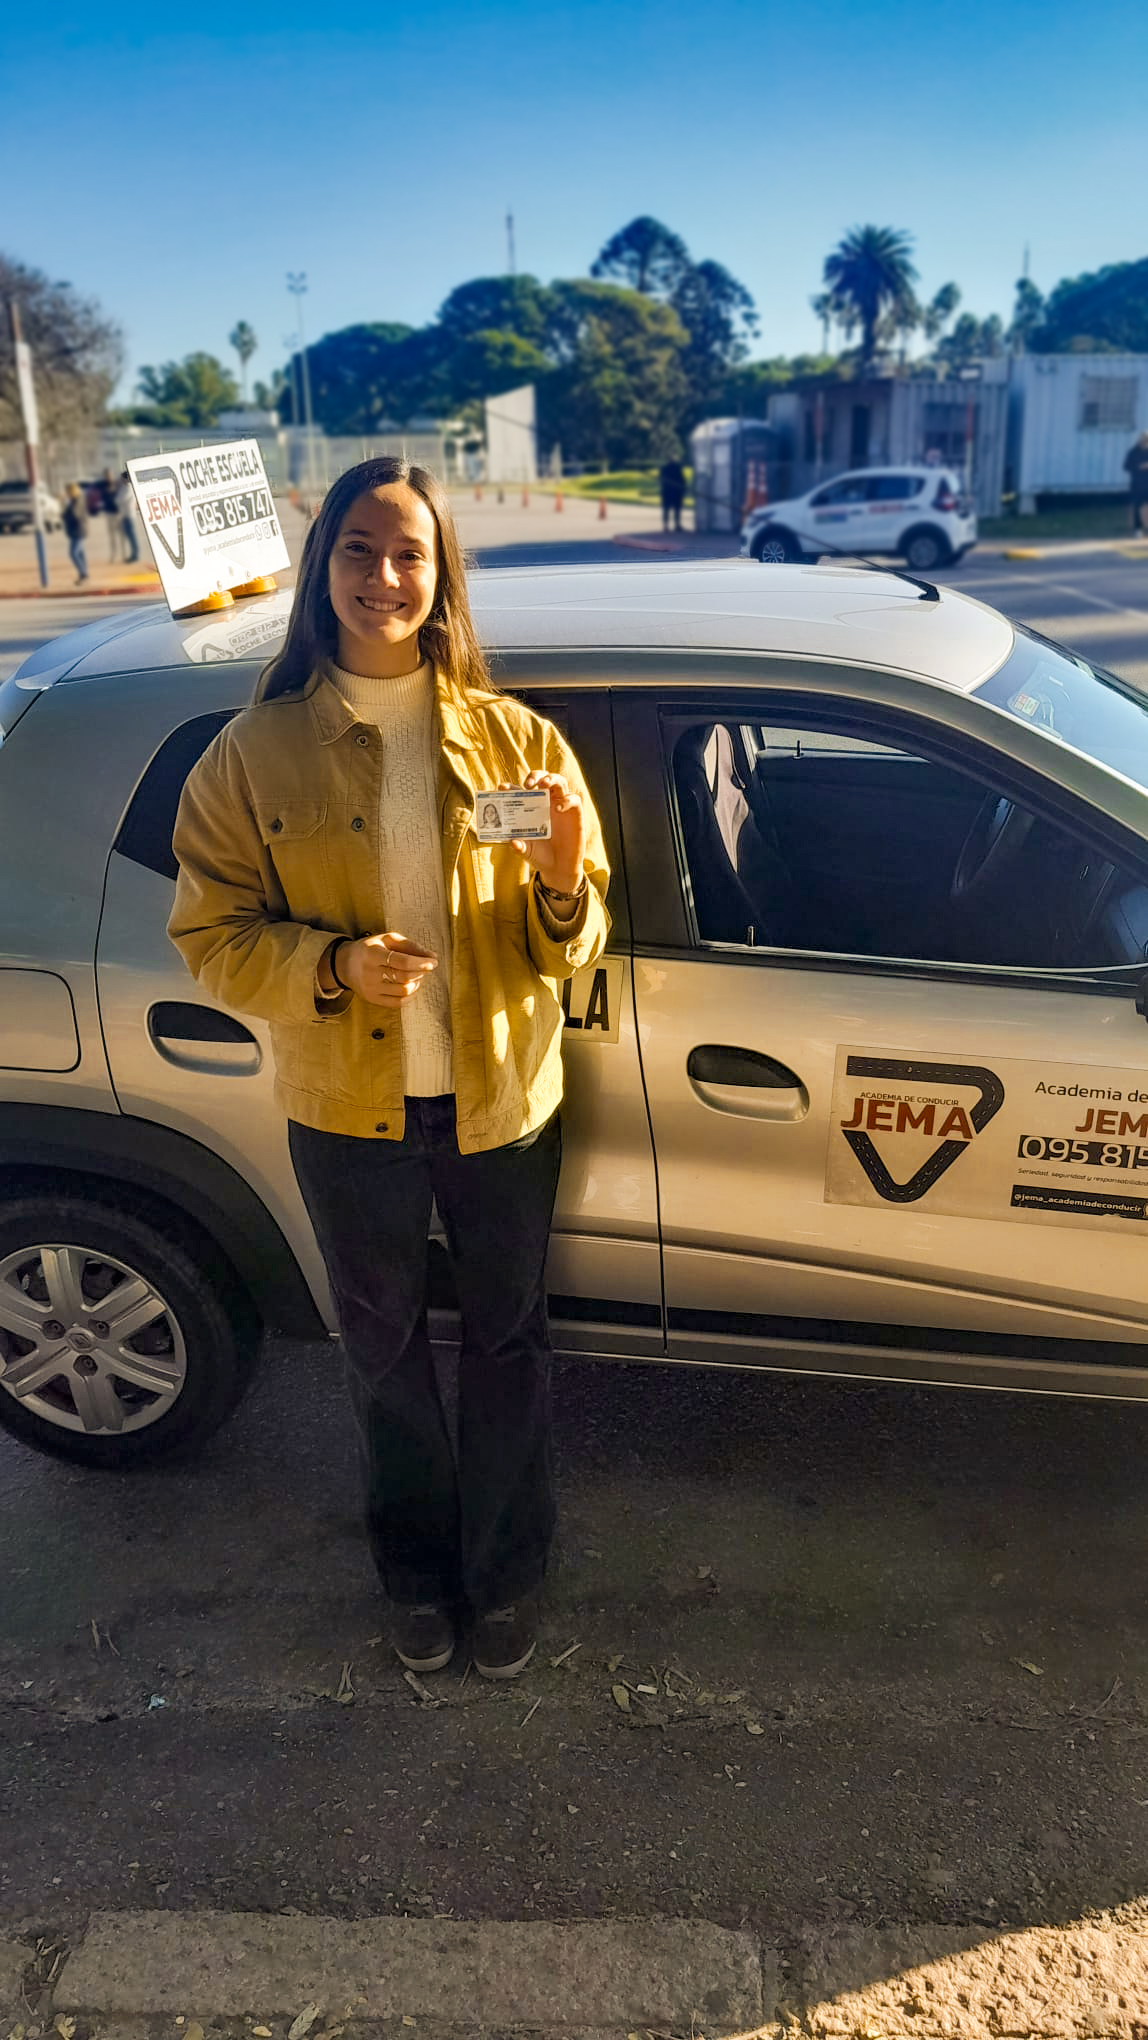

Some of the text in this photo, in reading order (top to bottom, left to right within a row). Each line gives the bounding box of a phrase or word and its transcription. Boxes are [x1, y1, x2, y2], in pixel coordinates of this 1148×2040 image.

[179, 449, 262, 490] COCHE ESCUELA
[146, 494, 182, 522] JEMA
[193, 501, 225, 535] 095
[223, 495, 249, 526] 815
[246, 489, 271, 519] 747
[860, 1091, 959, 1106] ACADEMIA DE CONDUCIR
[1035, 1081, 1148, 1103] Academia de
[840, 1097, 973, 1139] JEMA
[1021, 1136, 1148, 1170] 095 815
[1014, 1193, 1142, 1213] @jema_academiadeconducir
